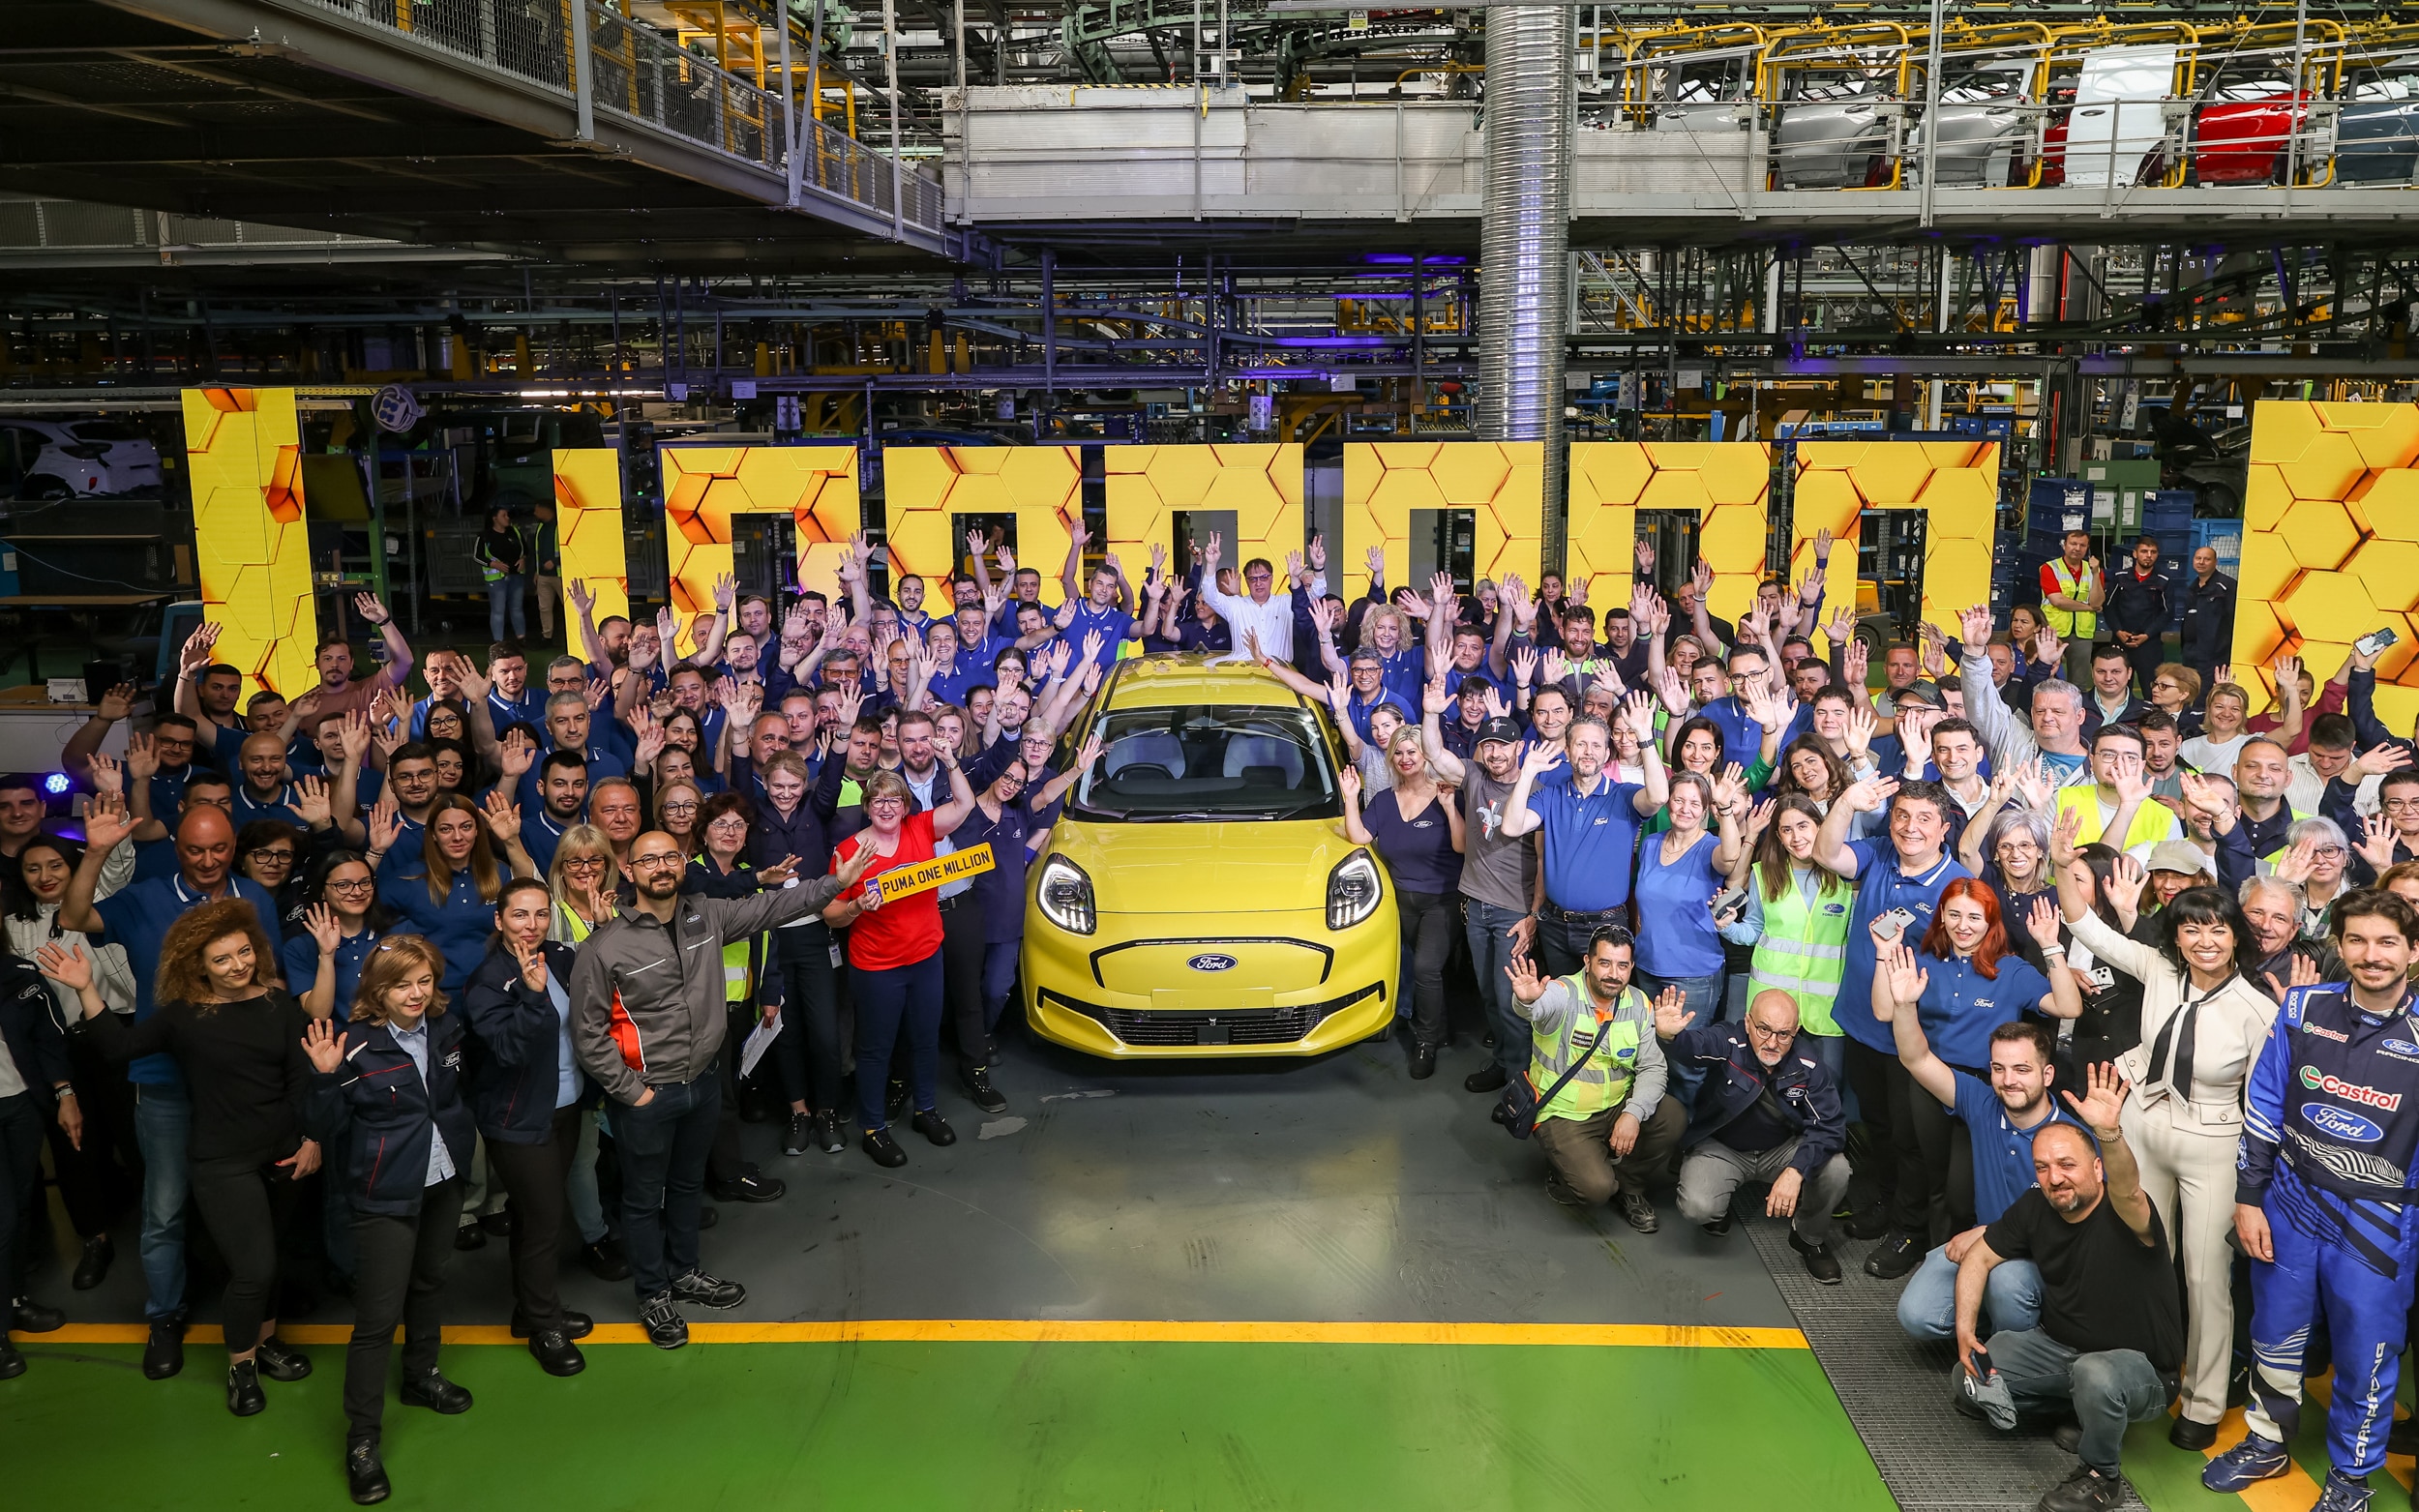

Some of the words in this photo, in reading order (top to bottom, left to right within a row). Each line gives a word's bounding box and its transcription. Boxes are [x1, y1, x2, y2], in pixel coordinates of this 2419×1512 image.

[1594, 817, 1609, 826] Ford
[881, 875, 915, 896] PUMA
[917, 865, 942, 884] ONE
[943, 850, 991, 876] MILLION
[1914, 902, 1934, 915] Ford
[1196, 955, 1228, 970] Ford
[1973, 997, 1995, 1008] Ford
[2363, 1016, 2378, 1025] Ford
[2313, 1026, 2349, 1043] Castrol
[2388, 1040, 2412, 1053] Ford
[445, 1052, 461, 1066] Ford
[2375, 1049, 2419, 1064] RACING
[1786, 1088, 1802, 1097] Ford
[2323, 1076, 2401, 1111] Castrol
[2314, 1107, 2367, 1140] Ford
